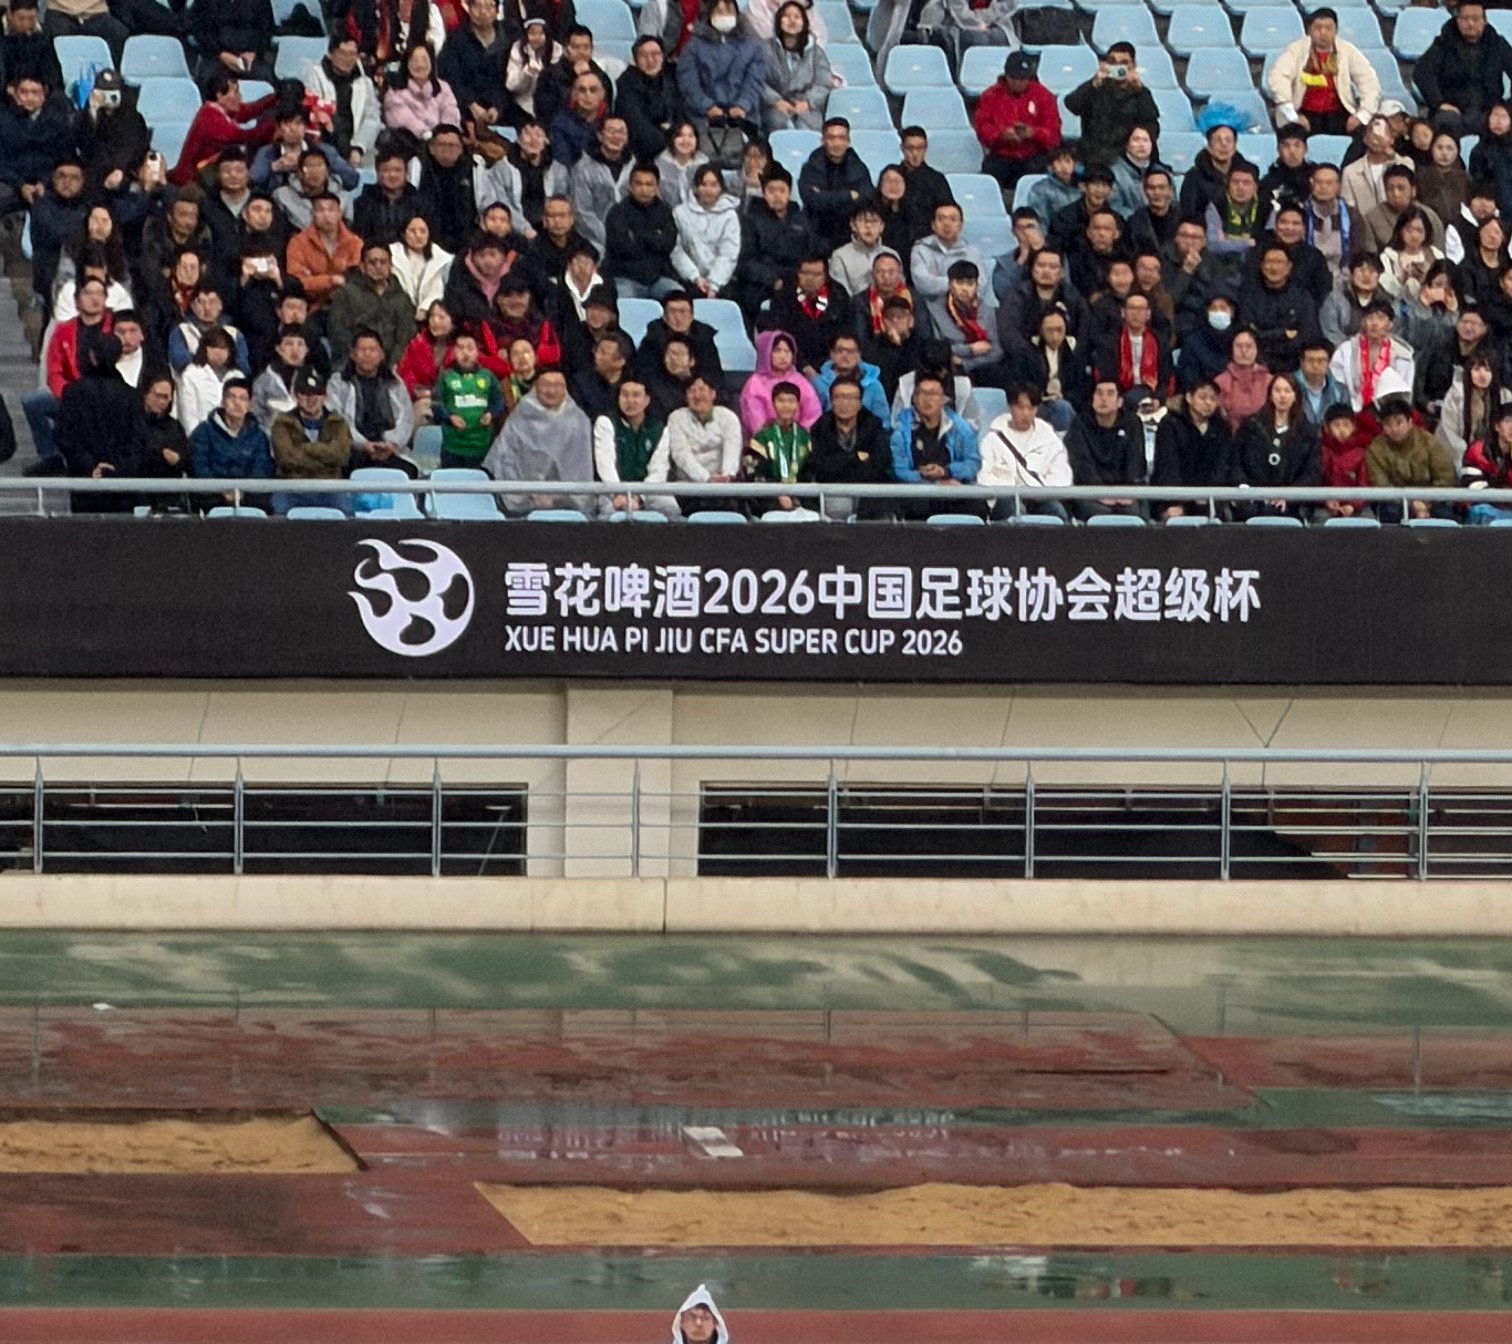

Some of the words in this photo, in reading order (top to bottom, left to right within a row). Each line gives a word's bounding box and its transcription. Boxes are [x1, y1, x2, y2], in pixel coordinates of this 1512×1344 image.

[505, 562, 1261, 623] 雪花啤酒2026中国足球协会超级杯
[504, 626, 556, 652] XUE
[563, 626, 619, 652] HUA
[626, 627, 649, 653] PI
[655, 627, 693, 654] JIU
[700, 627, 749, 654] CFA
[755, 627, 838, 654] SUPER
[845, 628, 896, 655] CUP
[902, 629, 963, 656] 2026
